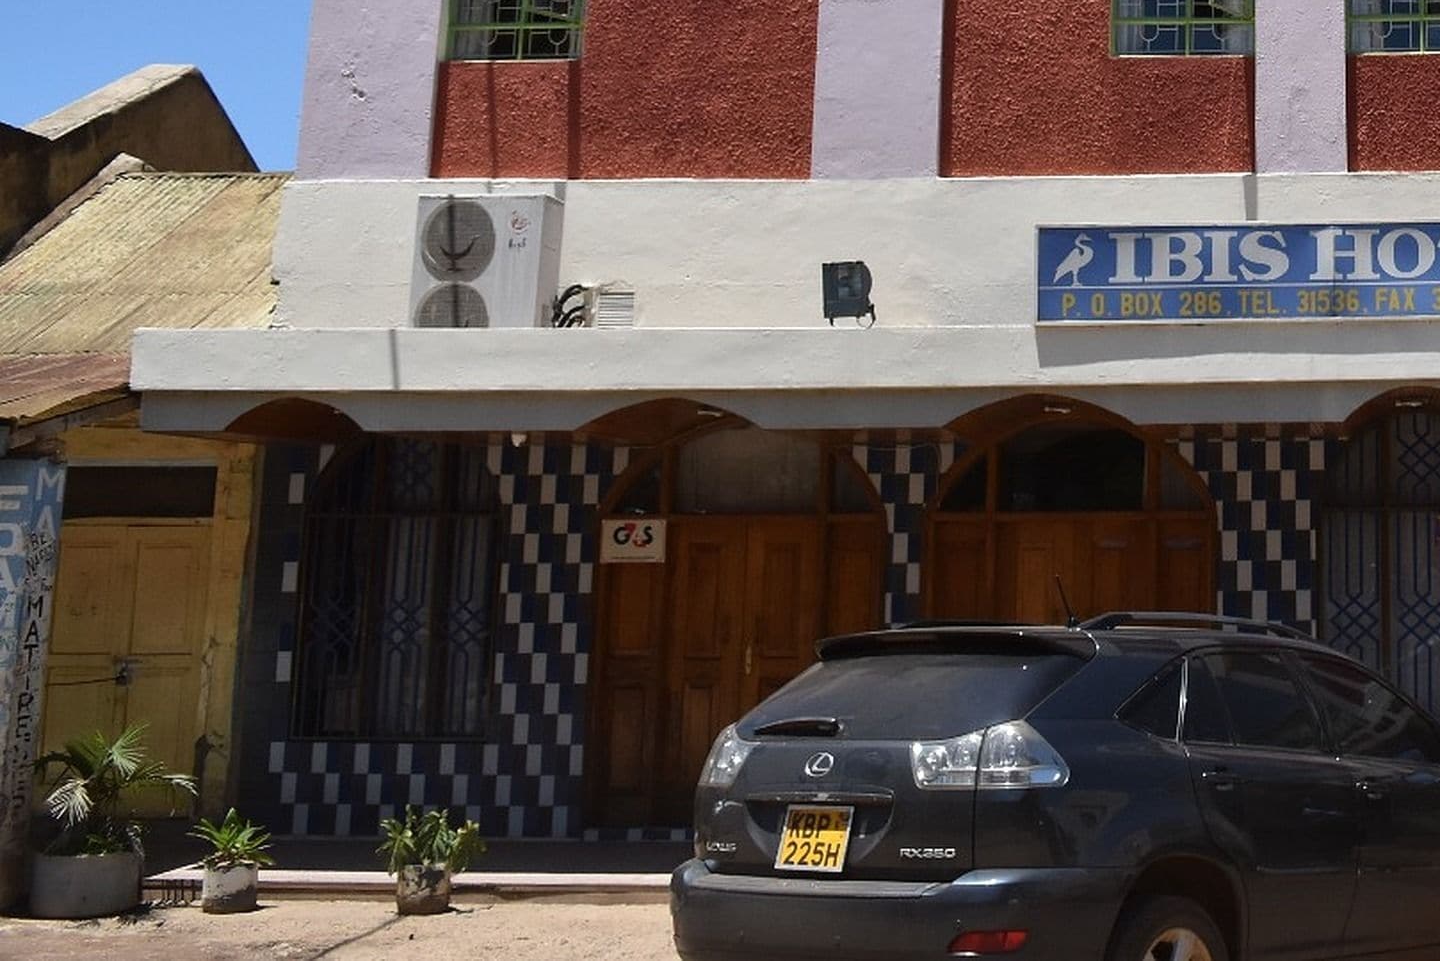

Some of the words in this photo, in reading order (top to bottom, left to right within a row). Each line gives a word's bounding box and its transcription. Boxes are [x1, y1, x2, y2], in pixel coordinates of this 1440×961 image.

[1108, 230, 1290, 283] IBIS
[1120, 292, 1164, 316] BOX
[1238, 289, 1287, 315] TEL.
[1374, 288, 1415, 311] FAX
[613, 523, 653, 547] G4S
[789, 812, 831, 838] KBP
[784, 842, 841, 867] 225H
